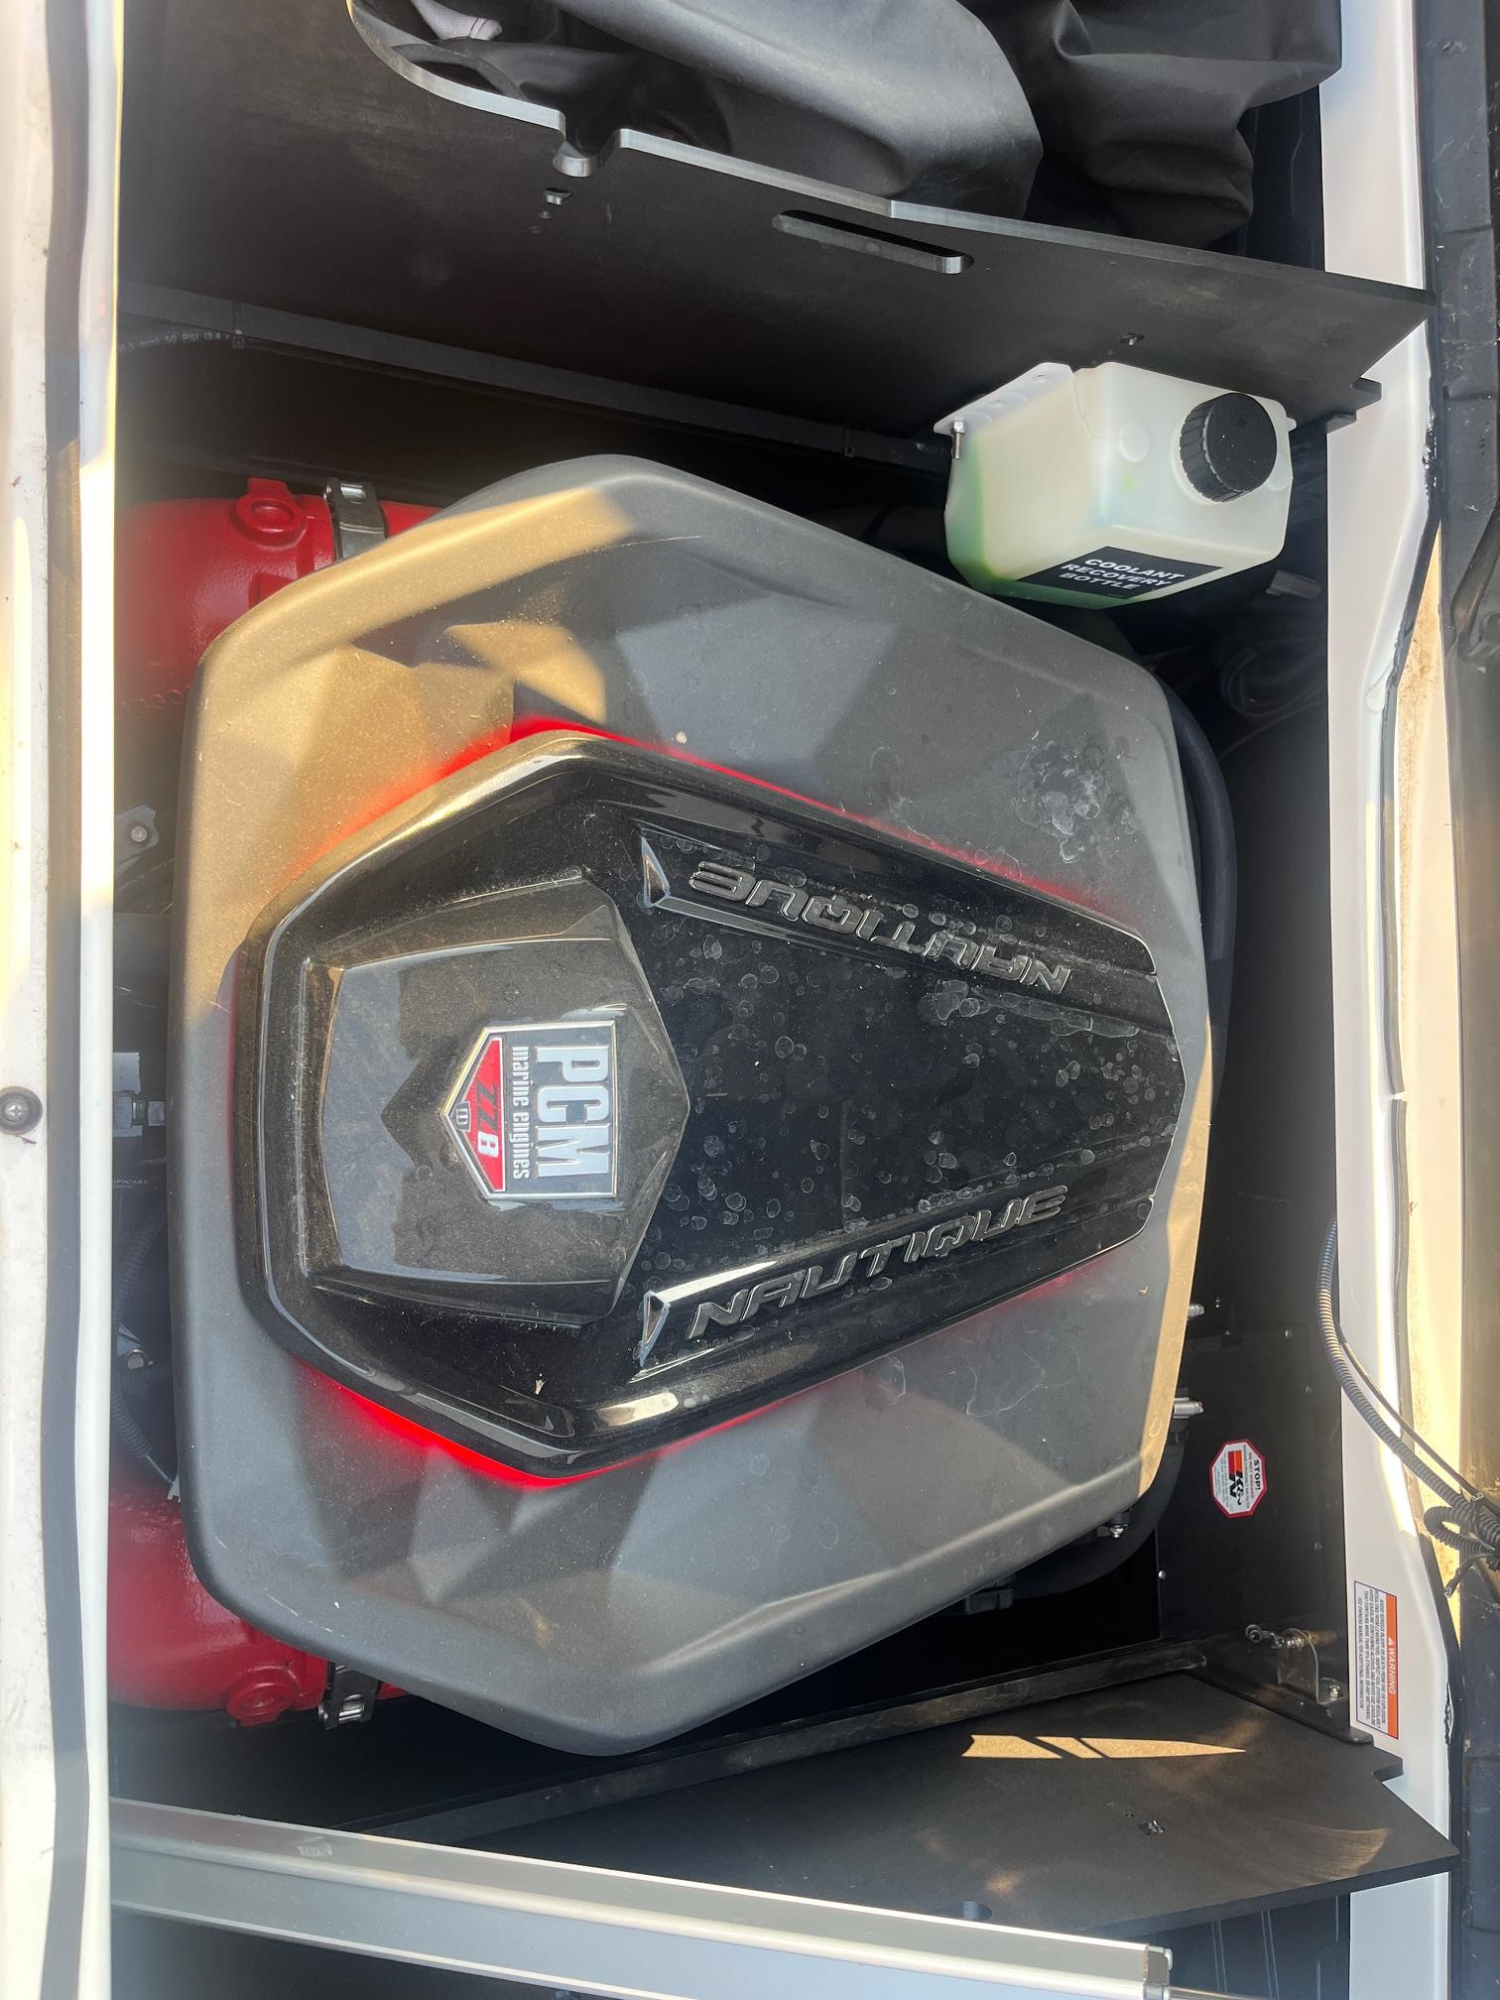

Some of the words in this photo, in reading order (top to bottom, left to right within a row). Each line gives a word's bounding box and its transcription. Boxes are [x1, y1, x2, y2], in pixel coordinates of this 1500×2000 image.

[182, 332, 199, 342] PSI
[1058, 572, 1140, 590] BOTTLE
[1060, 563, 1173, 586] RECOVERY
[1084, 558, 1185, 579] COOLANT
[688, 861, 1072, 994] NAUTIQUE
[512, 1046, 533, 1107] marine
[535, 1044, 610, 1178] PCM
[510, 1112, 534, 1179] engines
[686, 1184, 1069, 1340] NAUTIQUE
[1388, 1648, 1396, 1695] WARNING
